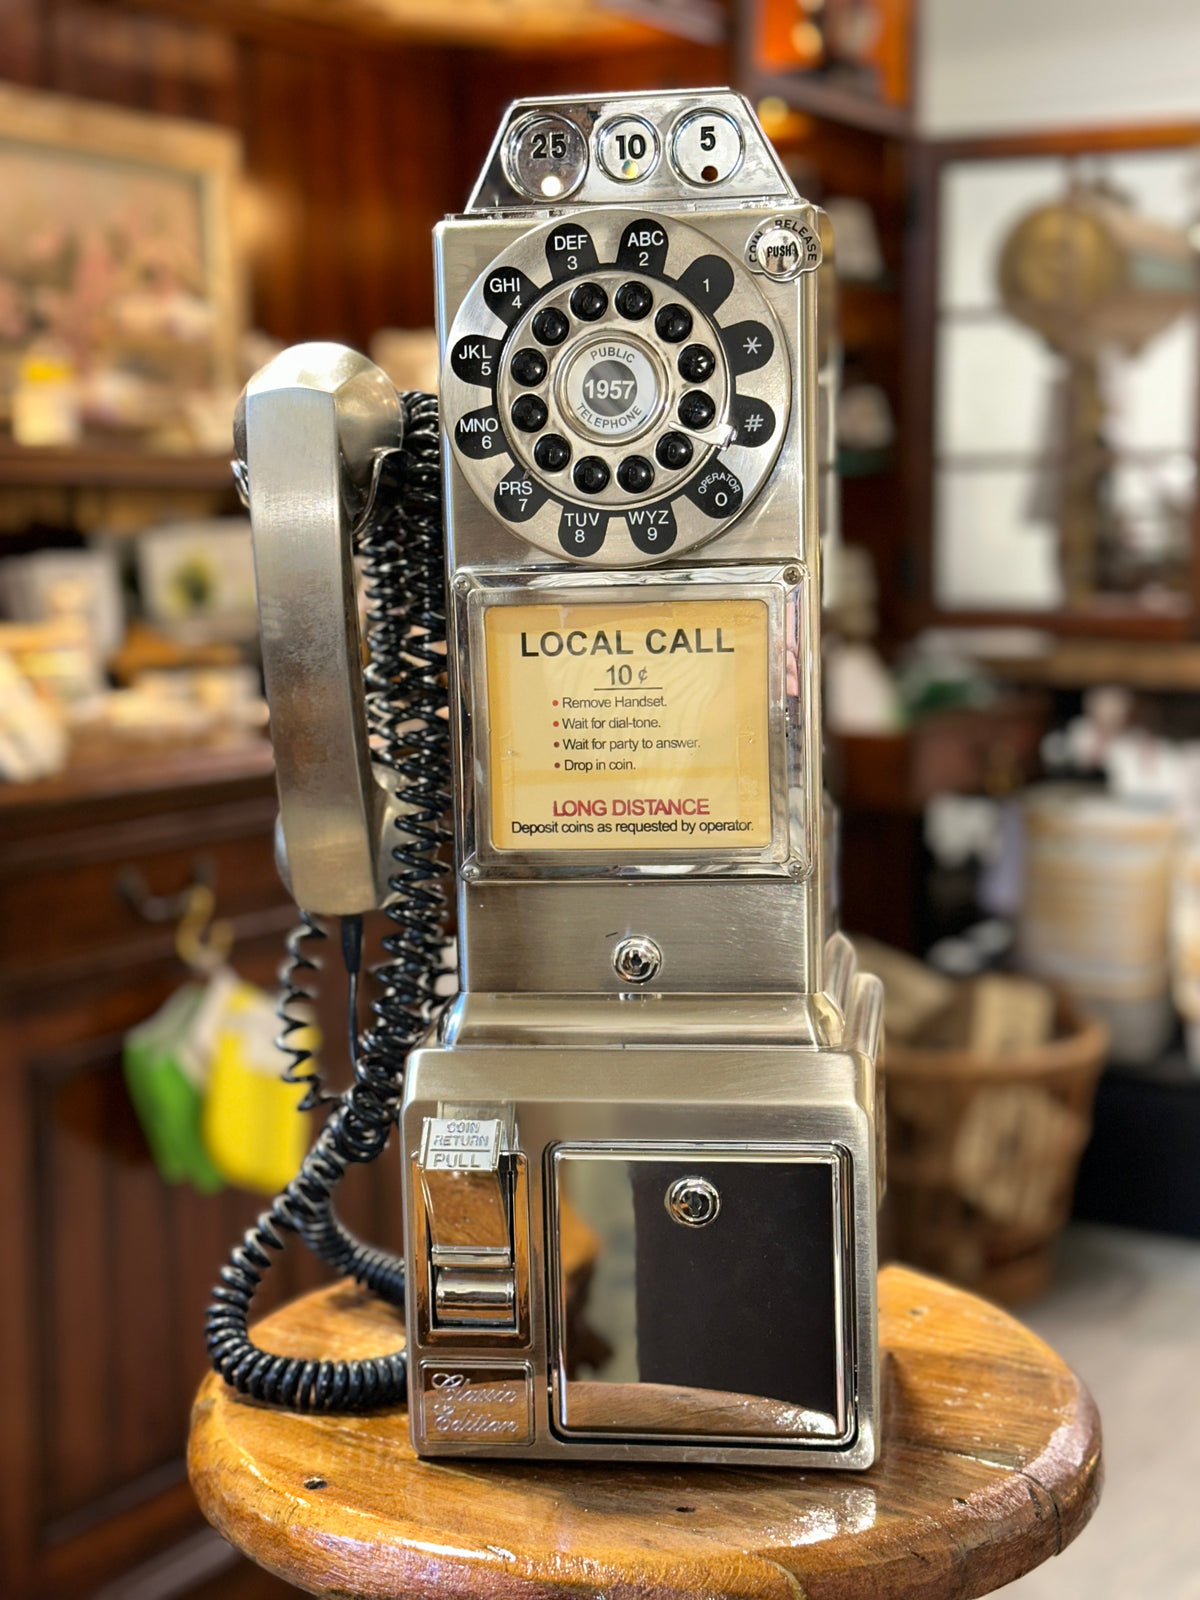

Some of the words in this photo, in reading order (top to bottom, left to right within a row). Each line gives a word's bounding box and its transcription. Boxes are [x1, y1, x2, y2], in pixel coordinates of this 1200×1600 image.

[532, 133, 566, 159] 25
[700, 126, 716, 151] 5
[616, 134, 646, 159] 10
[554, 234, 588, 250] DEF
[627, 231, 665, 247] ABC
[748, 231, 763, 263] COIN
[775, 219, 817, 261] RELEASE
[639, 252, 649, 266] 2
[767, 245, 792, 258] PUSH
[567, 256, 578, 270] 3
[489, 277, 521, 293] GHI
[702, 279, 710, 292] 1
[512, 295, 523, 309] 4
[459, 344, 492, 360] JKL
[590, 347, 635, 363] PUBLIC
[481, 362, 492, 376] 5
[584, 379, 635, 400] 1957
[577, 402, 642, 429] TELEPHONE
[459, 418, 499, 433] MNO
[481, 435, 492, 450] 6
[499, 481, 533, 496] PRS
[698, 472, 741, 494] OPERATOR
[519, 499, 528, 512] 7
[564, 512, 600, 527] TUV
[628, 511, 669, 525] WYZ
[575, 530, 585, 543] 8
[647, 527, 658, 541] 9
[520, 630, 634, 657] LOCAL
[645, 628, 735, 655] CALL
[606, 664, 632, 685] 10
[562, 697, 612, 709] Remove
[614, 696, 667, 708] Handset.
[562, 717, 588, 729] Wait
[590, 717, 606, 729] for
[609, 717, 661, 729] dial-tone.
[563, 738, 589, 750] Wait
[591, 738, 607, 750] for
[609, 738, 638, 752] party
[642, 739, 653, 749] to
[655, 739, 701, 749] answer.
[564, 759, 593, 773] Drop
[596, 759, 606, 770] in
[608, 759, 636, 770] coin.
[553, 800, 607, 817] LONG
[612, 798, 710, 816] DISTANCE
[511, 820, 559, 837] Deposit
[561, 821, 594, 833] coins
[597, 823, 613, 833] as
[615, 820, 677, 835] requested
[681, 820, 696, 834] by
[699, 820, 754, 835] operator.
[447, 1121, 480, 1134] COIN
[433, 1135, 489, 1147] RETURN
[433, 1153, 481, 1168] PULL
[431, 1373, 517, 1402] Classic
[433, 1404, 519, 1432] Edition
